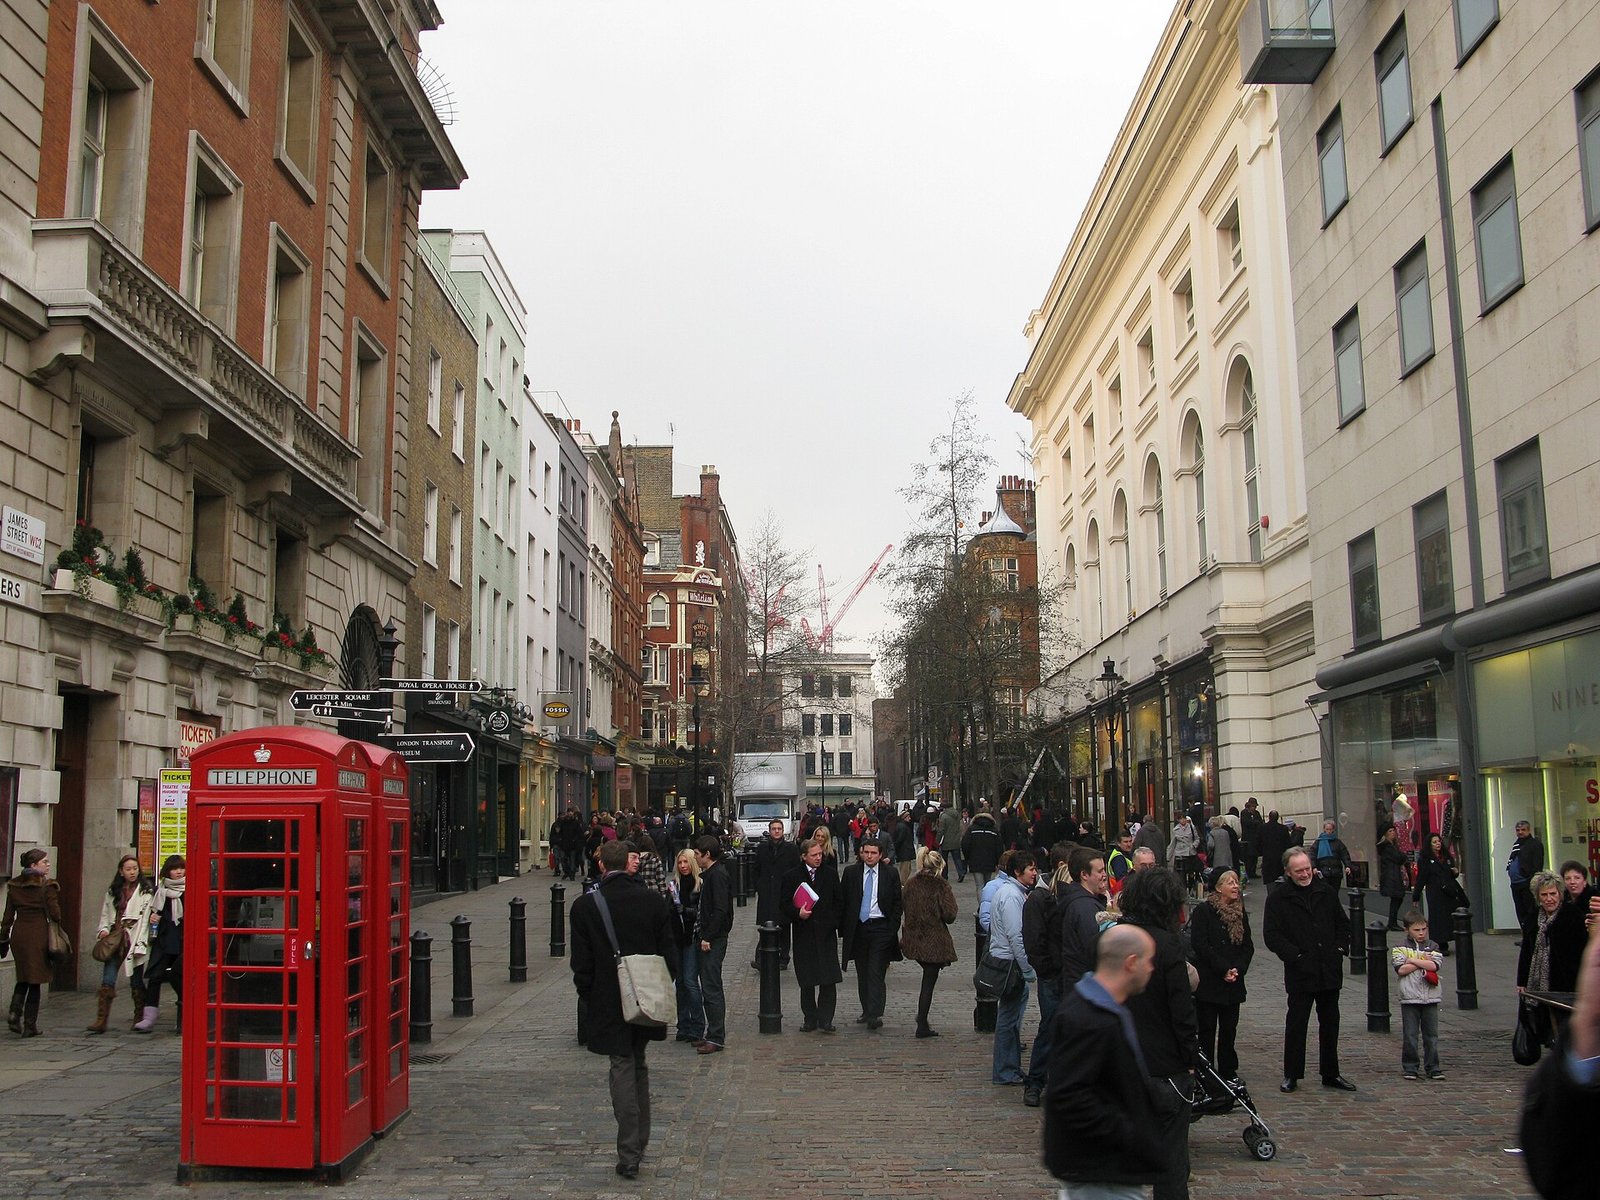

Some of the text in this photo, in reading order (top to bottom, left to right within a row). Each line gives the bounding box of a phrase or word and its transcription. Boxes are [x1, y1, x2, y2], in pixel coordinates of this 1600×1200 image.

[7, 512, 28, 530] JAMES
[6, 525, 42, 550] STREET WC2
[692, 623, 709, 633] WHITE
[305, 693, 340, 701] LEICESTER
[340, 700, 353, 708] Min
[1551, 683, 1599, 712] NINE
[353, 710, 363, 718] WC
[180, 723, 213, 744] TICKETS
[422, 739, 454, 747] TRANSPORT
[212, 770, 313, 785] TELEPHONE
[384, 779, 403, 793] ELEPHONE
